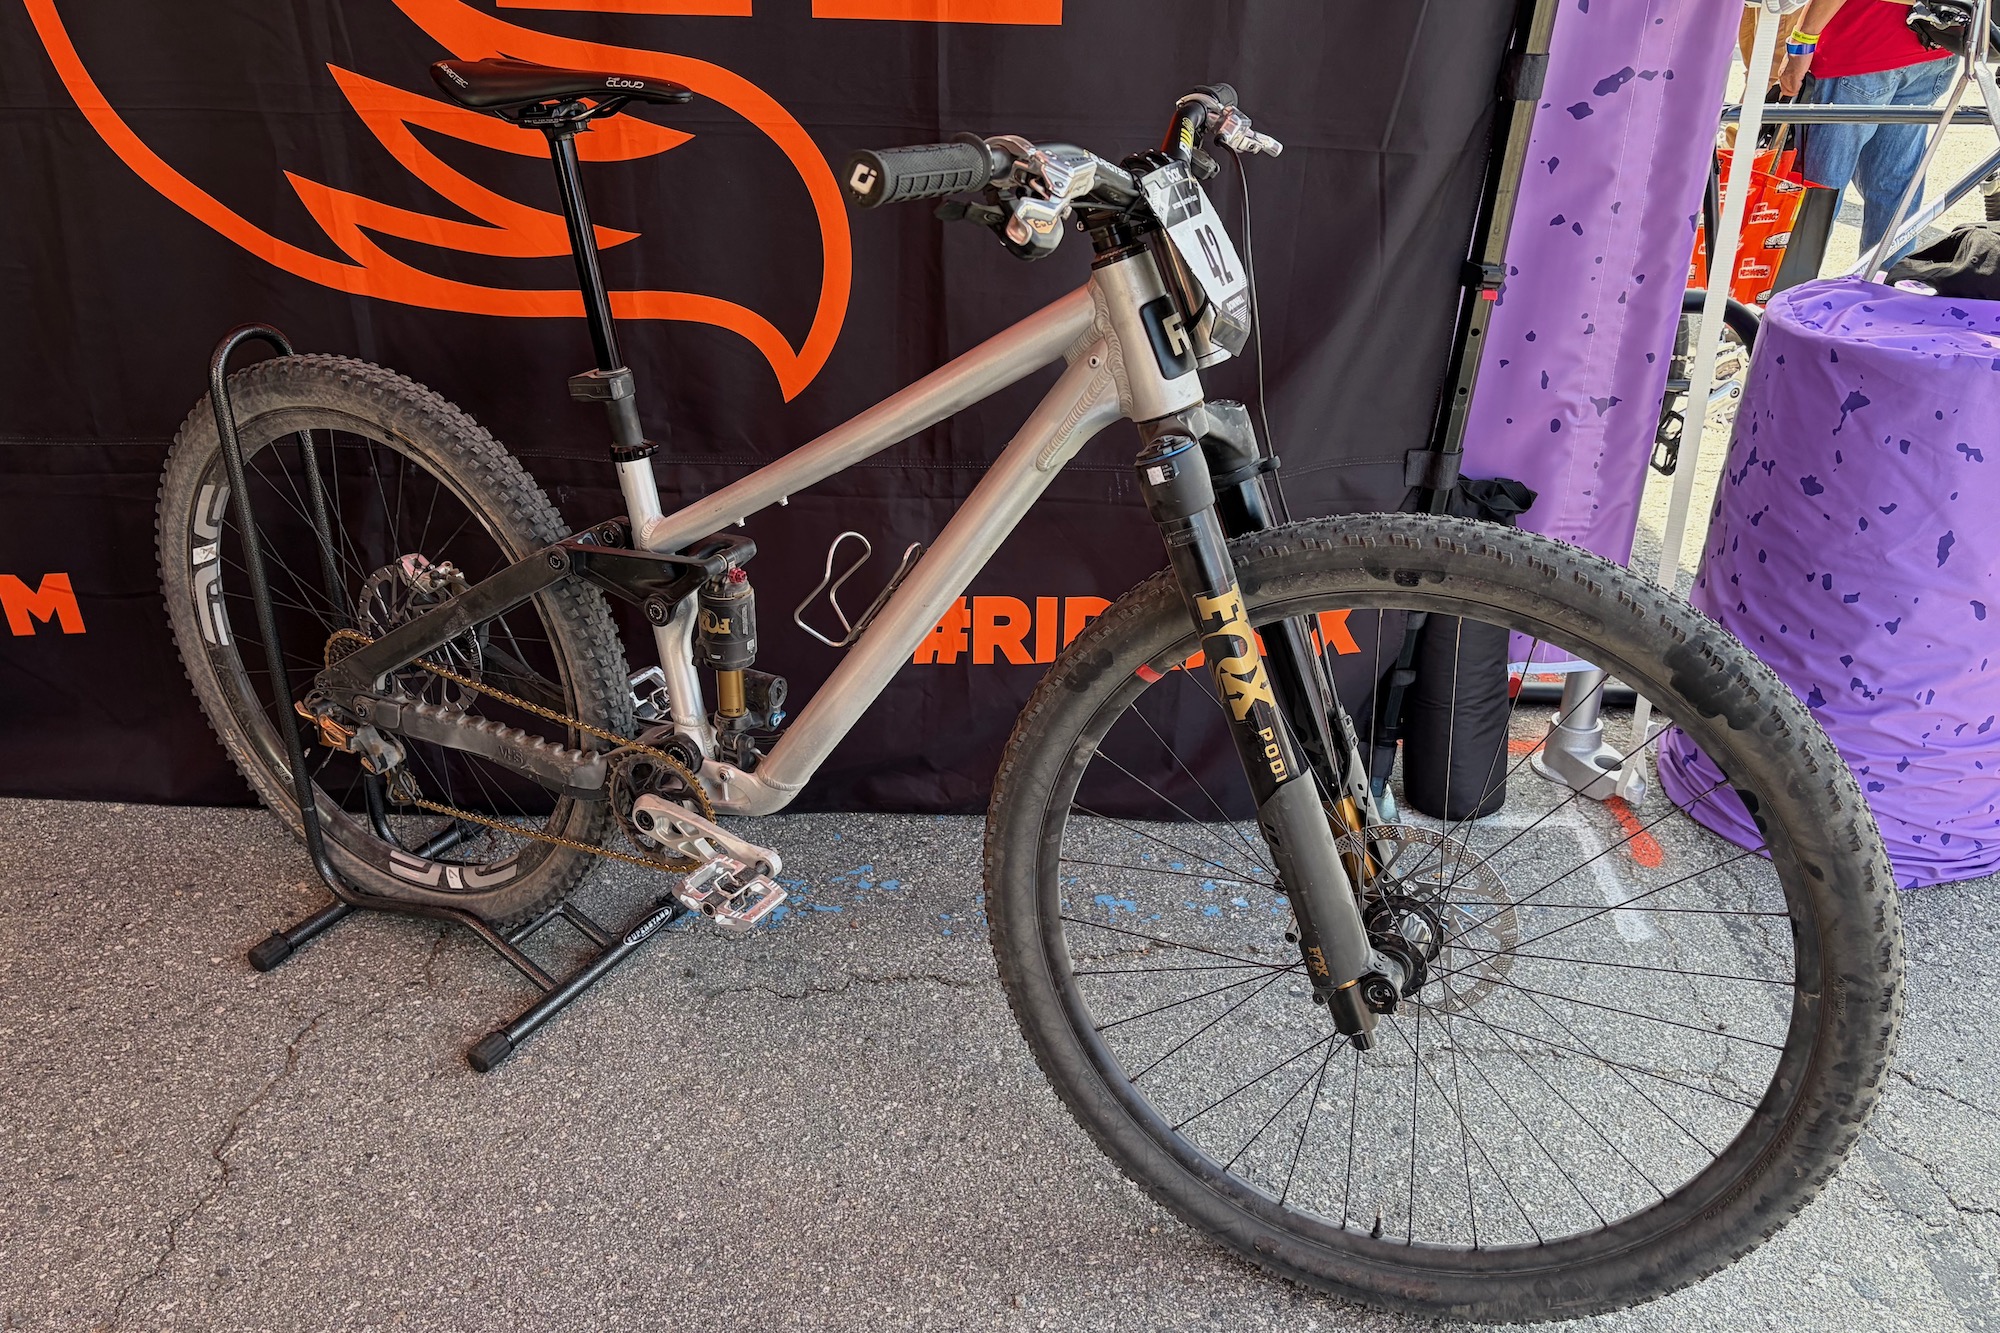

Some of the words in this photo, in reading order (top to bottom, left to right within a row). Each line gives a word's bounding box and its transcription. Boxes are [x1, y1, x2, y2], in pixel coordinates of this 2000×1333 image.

[606, 80, 644, 88] CLOUD
[1194, 224, 1234, 287] 42
[1196, 583, 1276, 722] FOX
[224, 728, 308, 840] ONTINENTAL
[626, 908, 670, 943] SUPERSTAND
[1308, 945, 1329, 977] FOX
